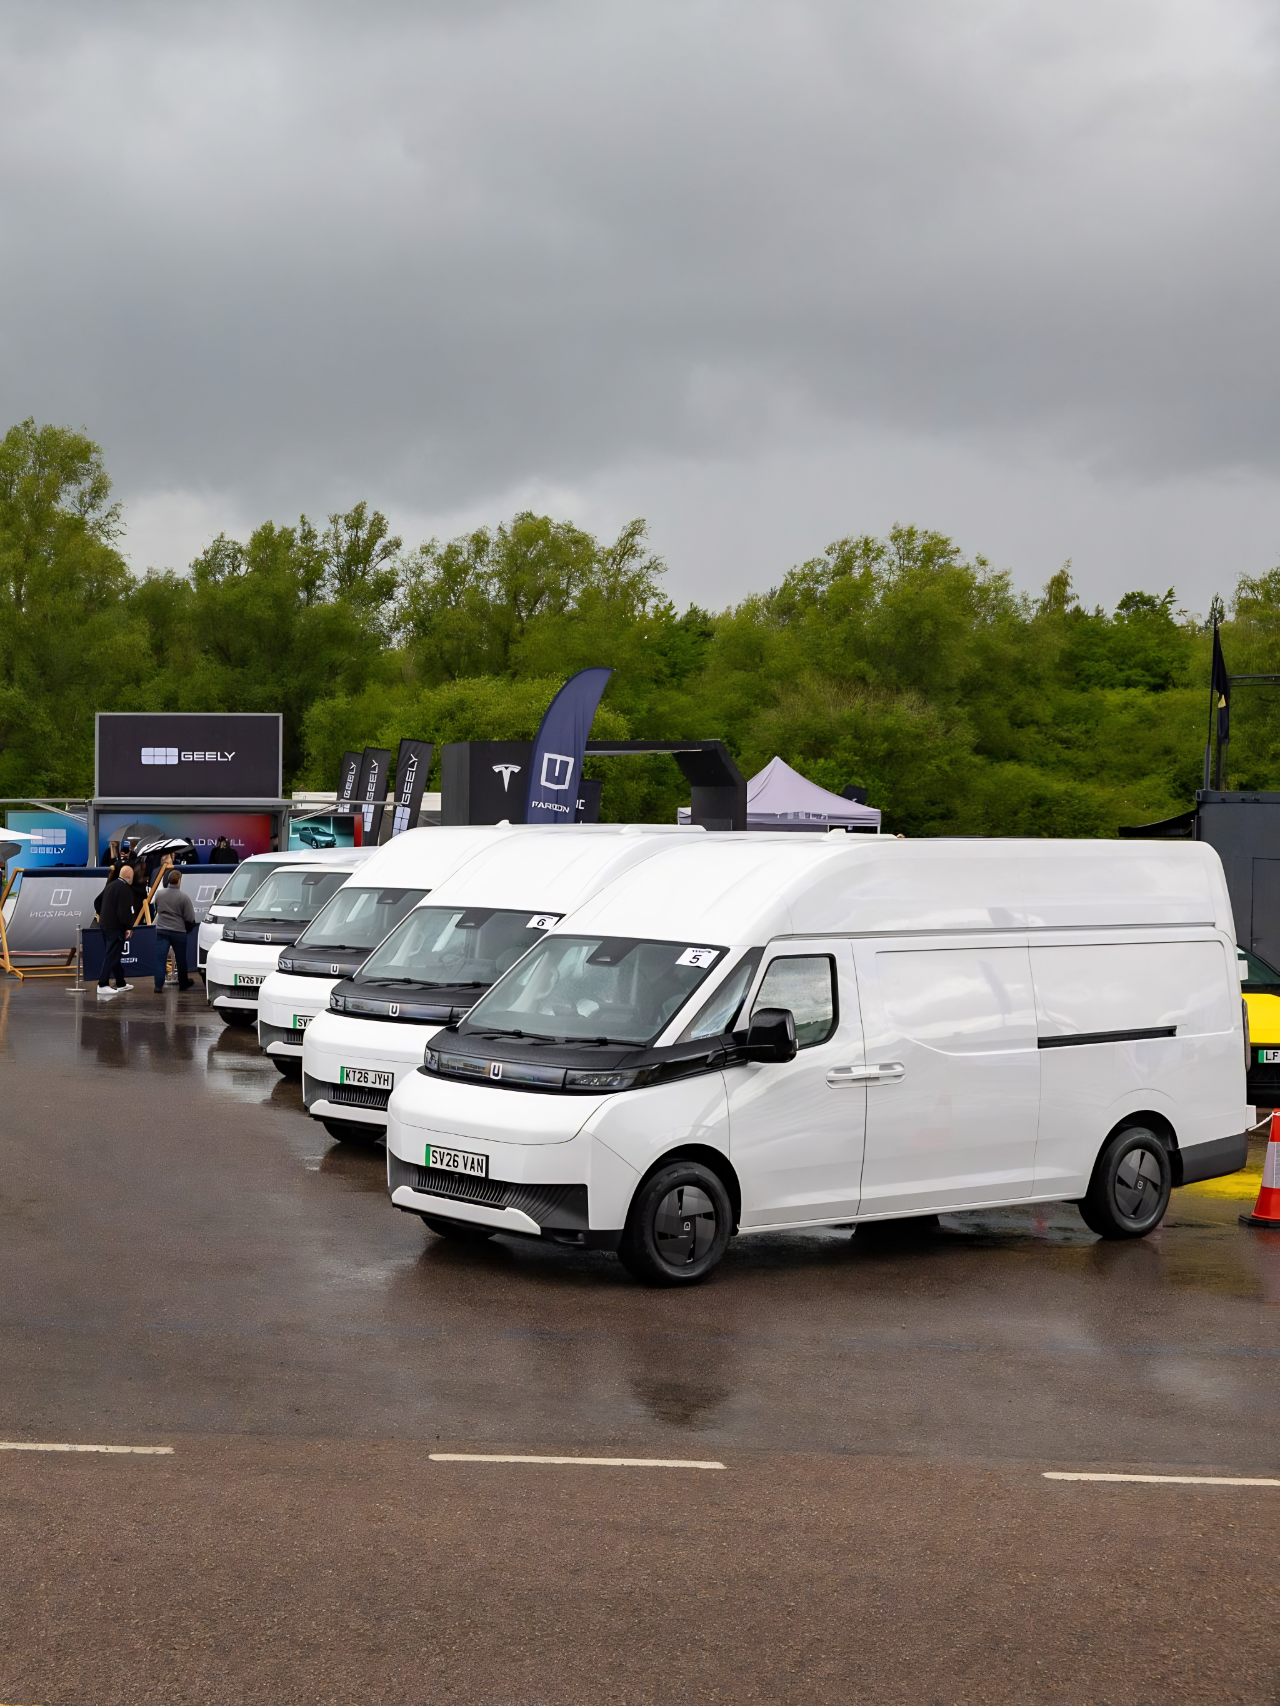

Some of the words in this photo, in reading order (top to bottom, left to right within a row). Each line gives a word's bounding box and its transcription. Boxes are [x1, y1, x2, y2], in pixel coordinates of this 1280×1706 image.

[180, 751, 236, 762] GEELY
[343, 761, 356, 799] GEELY
[365, 759, 379, 801] GEELY
[400, 753, 418, 805] GEELY
[536, 918, 547, 927] 6
[688, 954, 702, 964] 5
[345, 1069, 369, 1084] KT26
[370, 1072, 390, 1087] JYH
[431, 1150, 459, 1169] SV26
[462, 1155, 484, 1174] VAN
